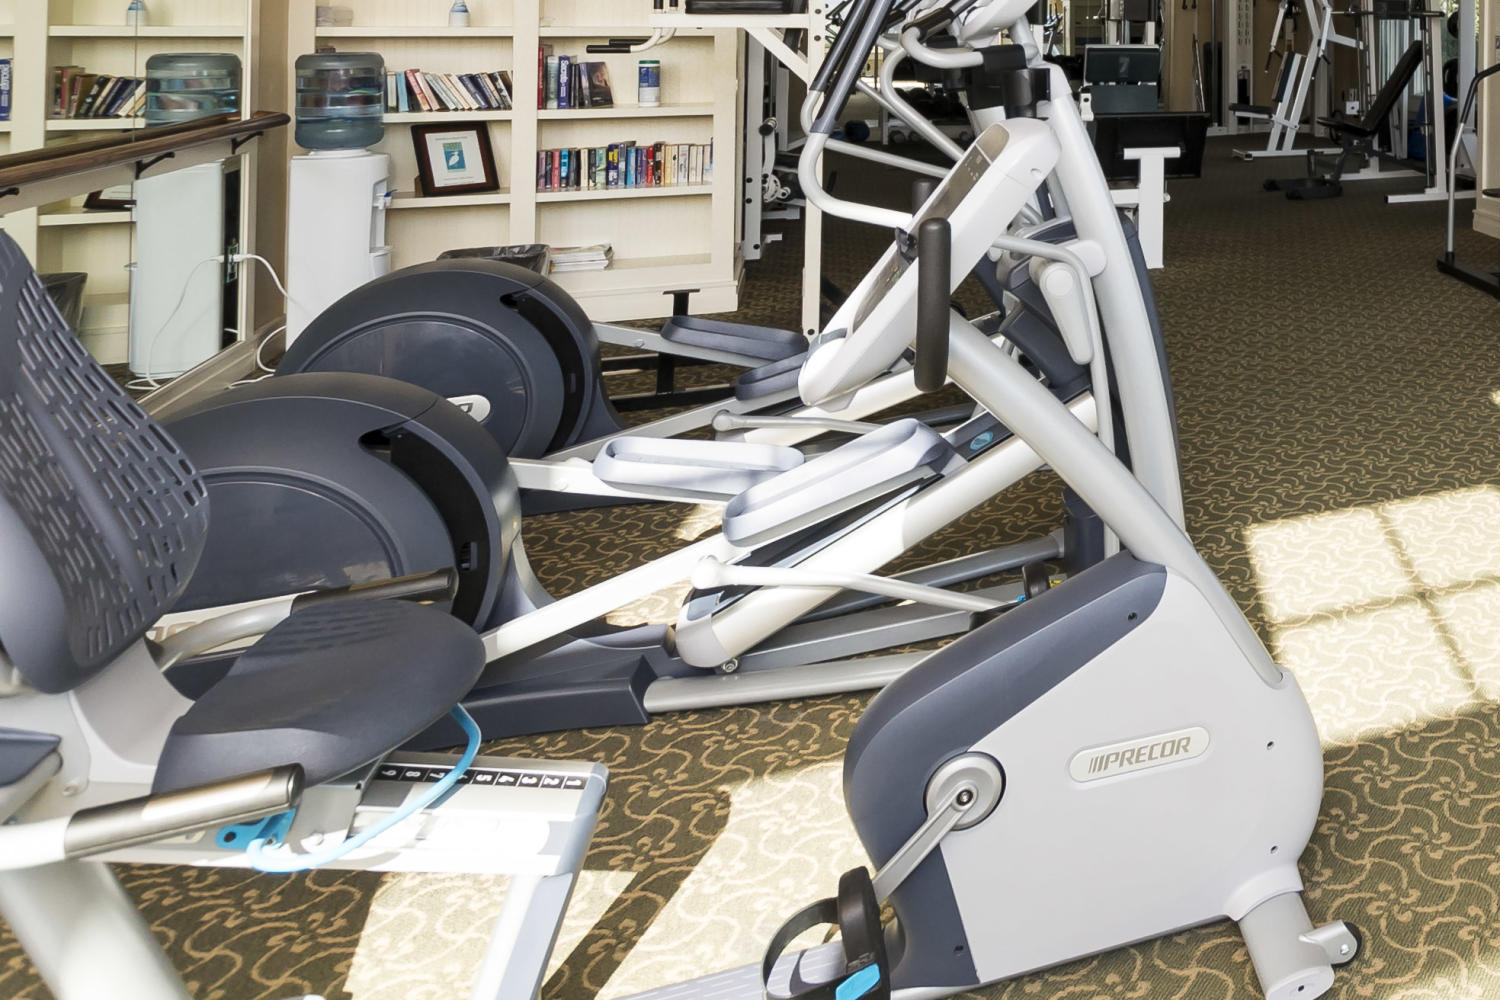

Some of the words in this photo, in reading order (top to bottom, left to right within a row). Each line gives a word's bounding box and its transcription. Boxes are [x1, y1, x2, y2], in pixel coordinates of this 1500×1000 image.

[1103, 736, 1191, 771] PRECOR
[405, 770, 421, 778] 8
[476, 774, 491, 782] 5
[521, 775, 538, 785] 3
[543, 776, 561, 786] 2
[565, 778, 582, 787] 1
